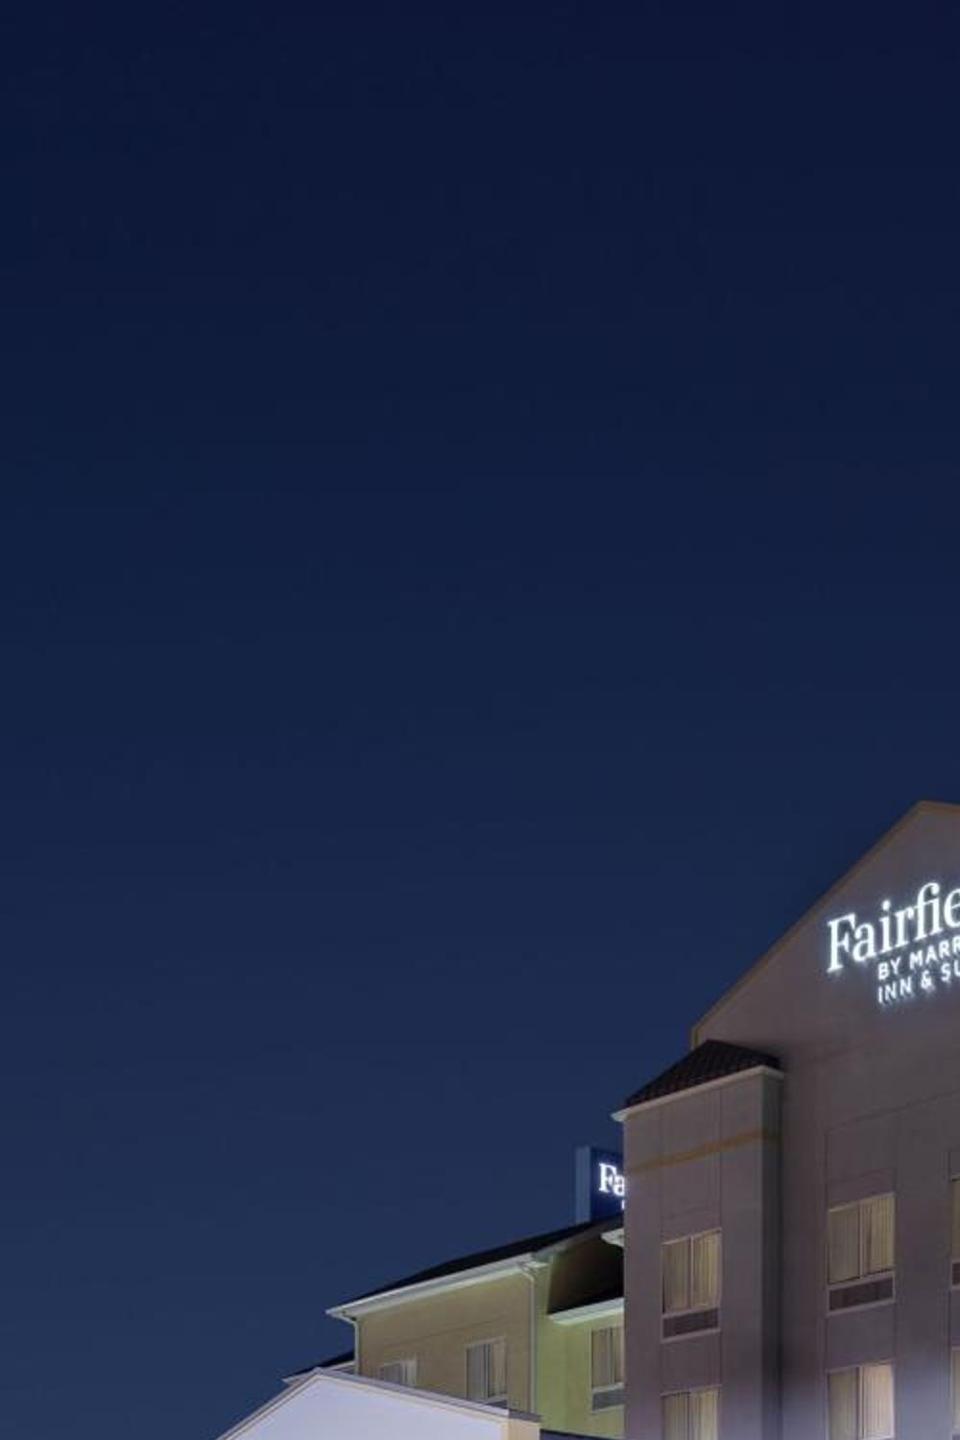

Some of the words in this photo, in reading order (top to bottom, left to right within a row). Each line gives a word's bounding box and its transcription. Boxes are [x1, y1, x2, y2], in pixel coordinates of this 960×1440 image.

[878, 957, 901, 980] BY
[878, 977, 912, 1004] INN
[920, 970, 932, 989] &
